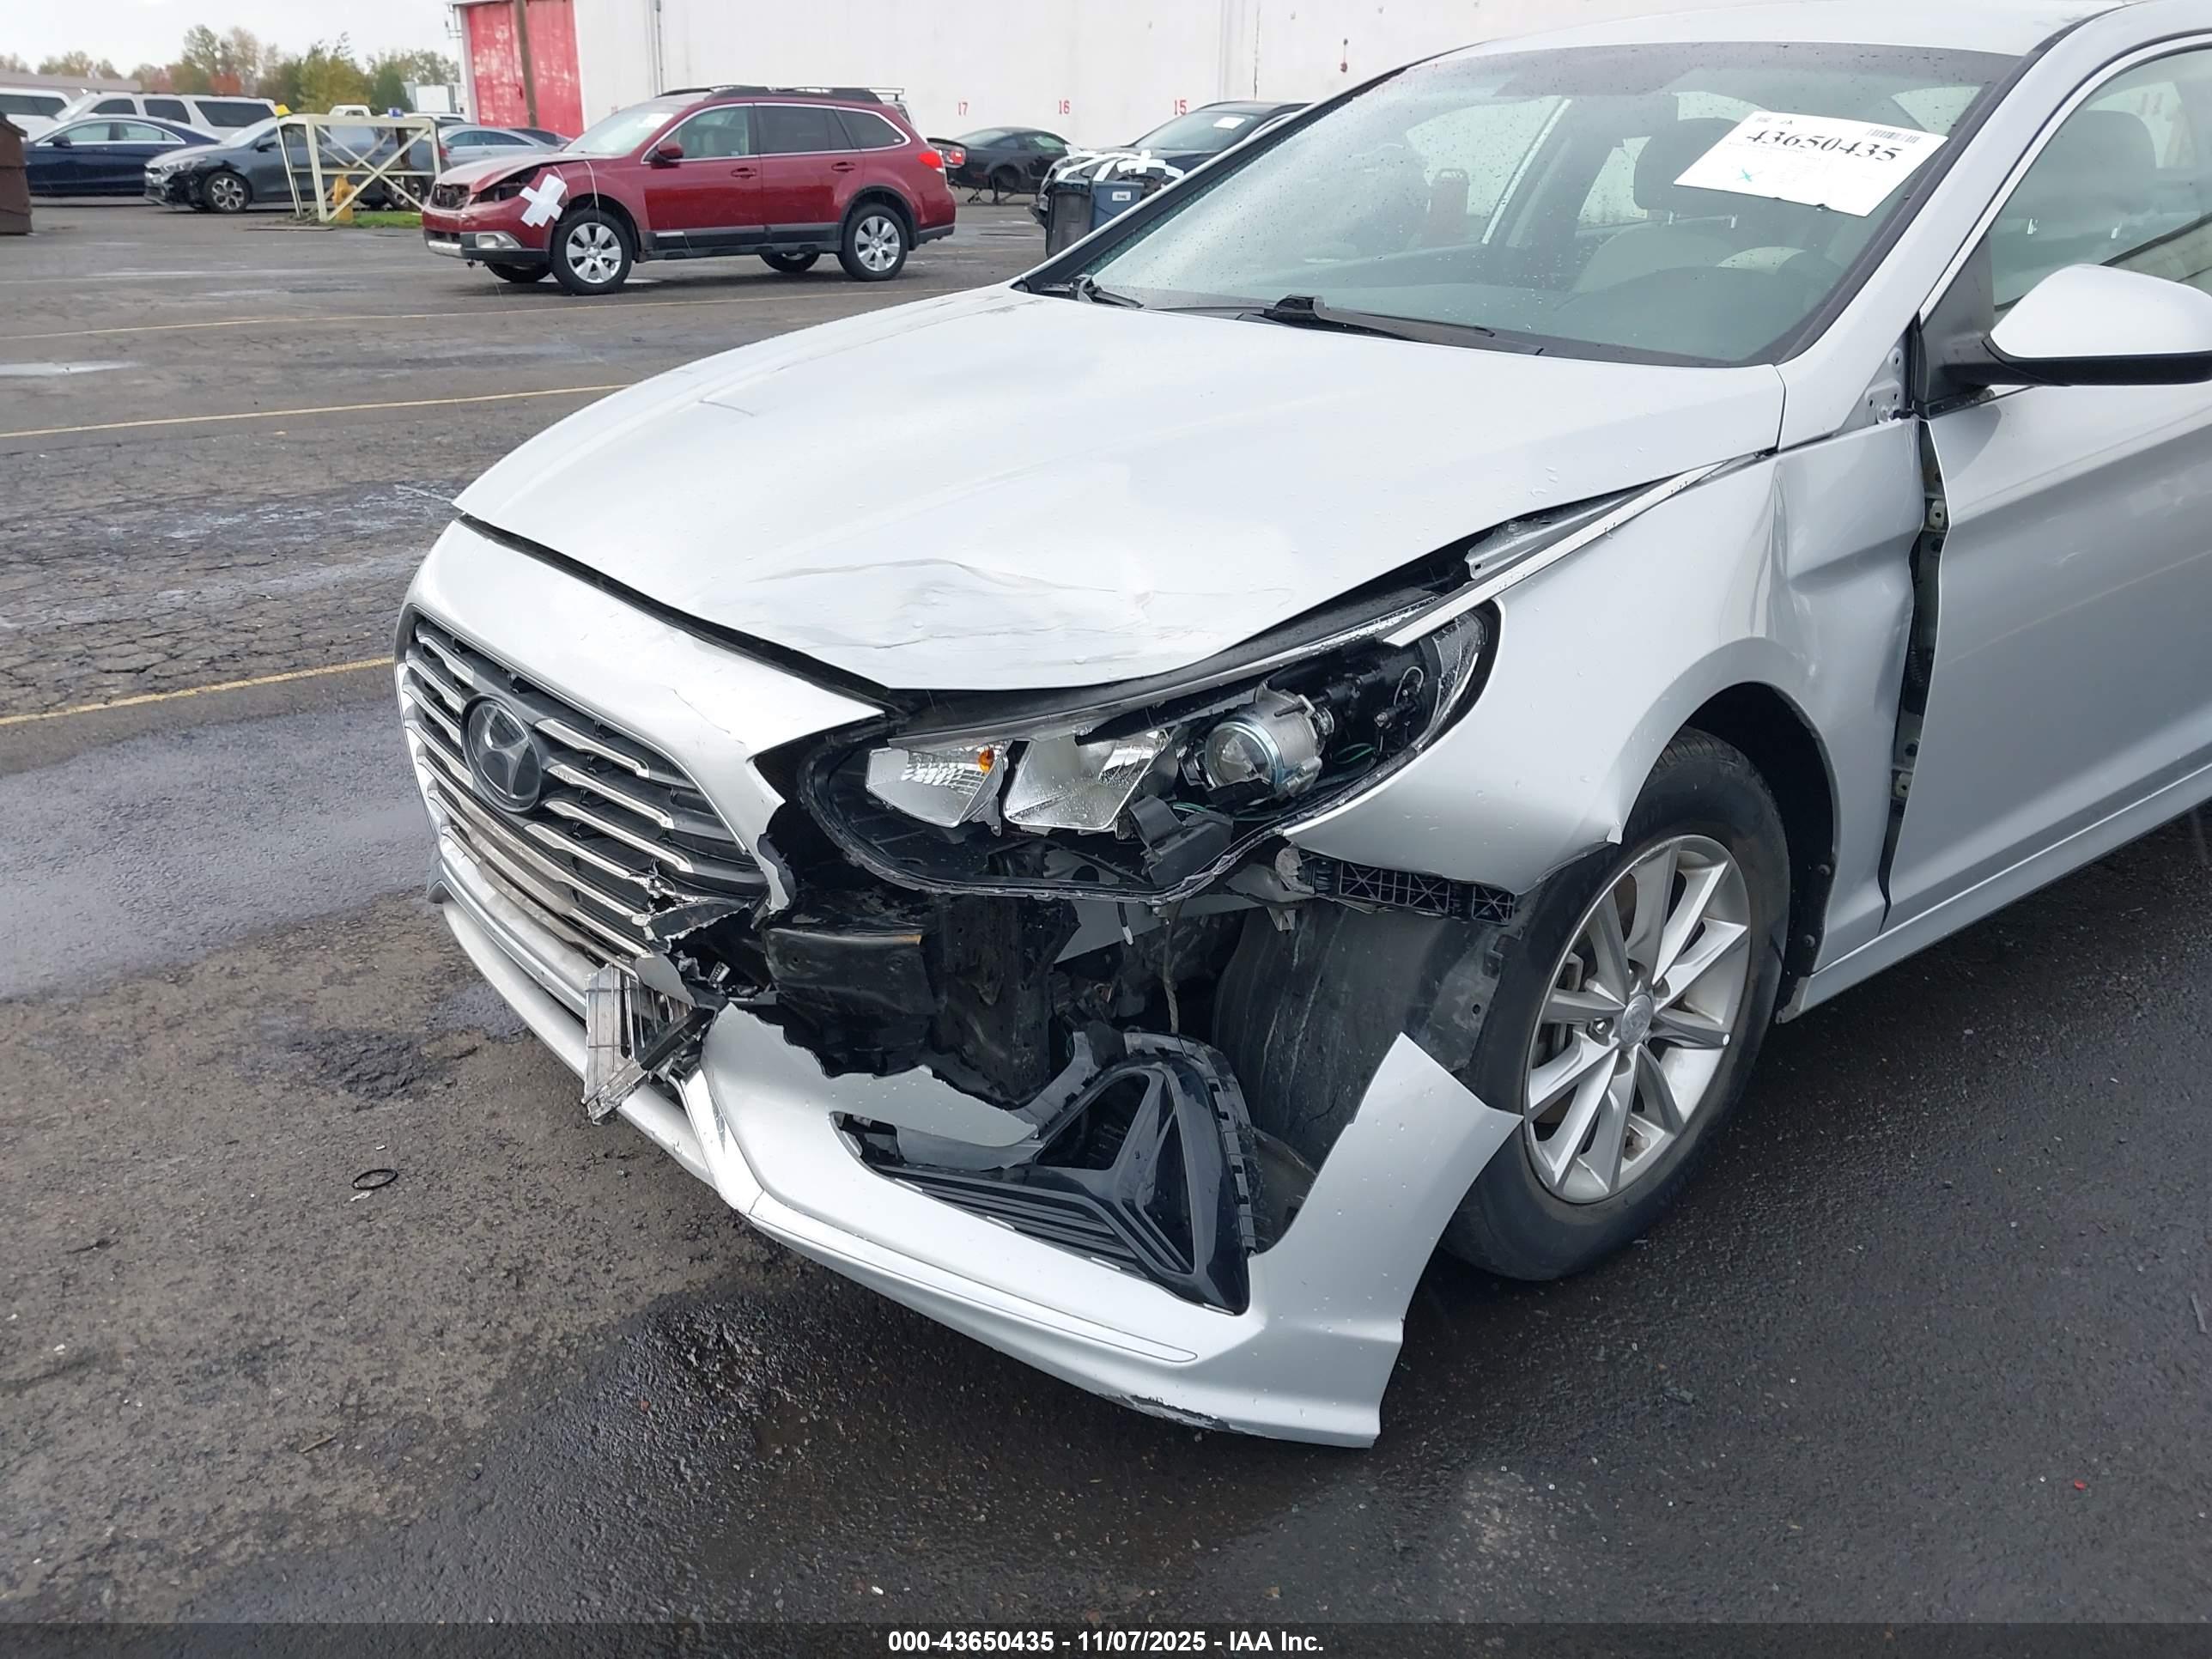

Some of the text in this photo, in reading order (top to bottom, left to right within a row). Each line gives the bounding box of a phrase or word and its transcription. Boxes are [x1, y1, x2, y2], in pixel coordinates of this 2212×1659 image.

[957, 102, 969, 116] 17
[1058, 100, 1071, 114] 16
[1174, 99, 1188, 116] 15
[1746, 130, 1904, 162] 43650435
